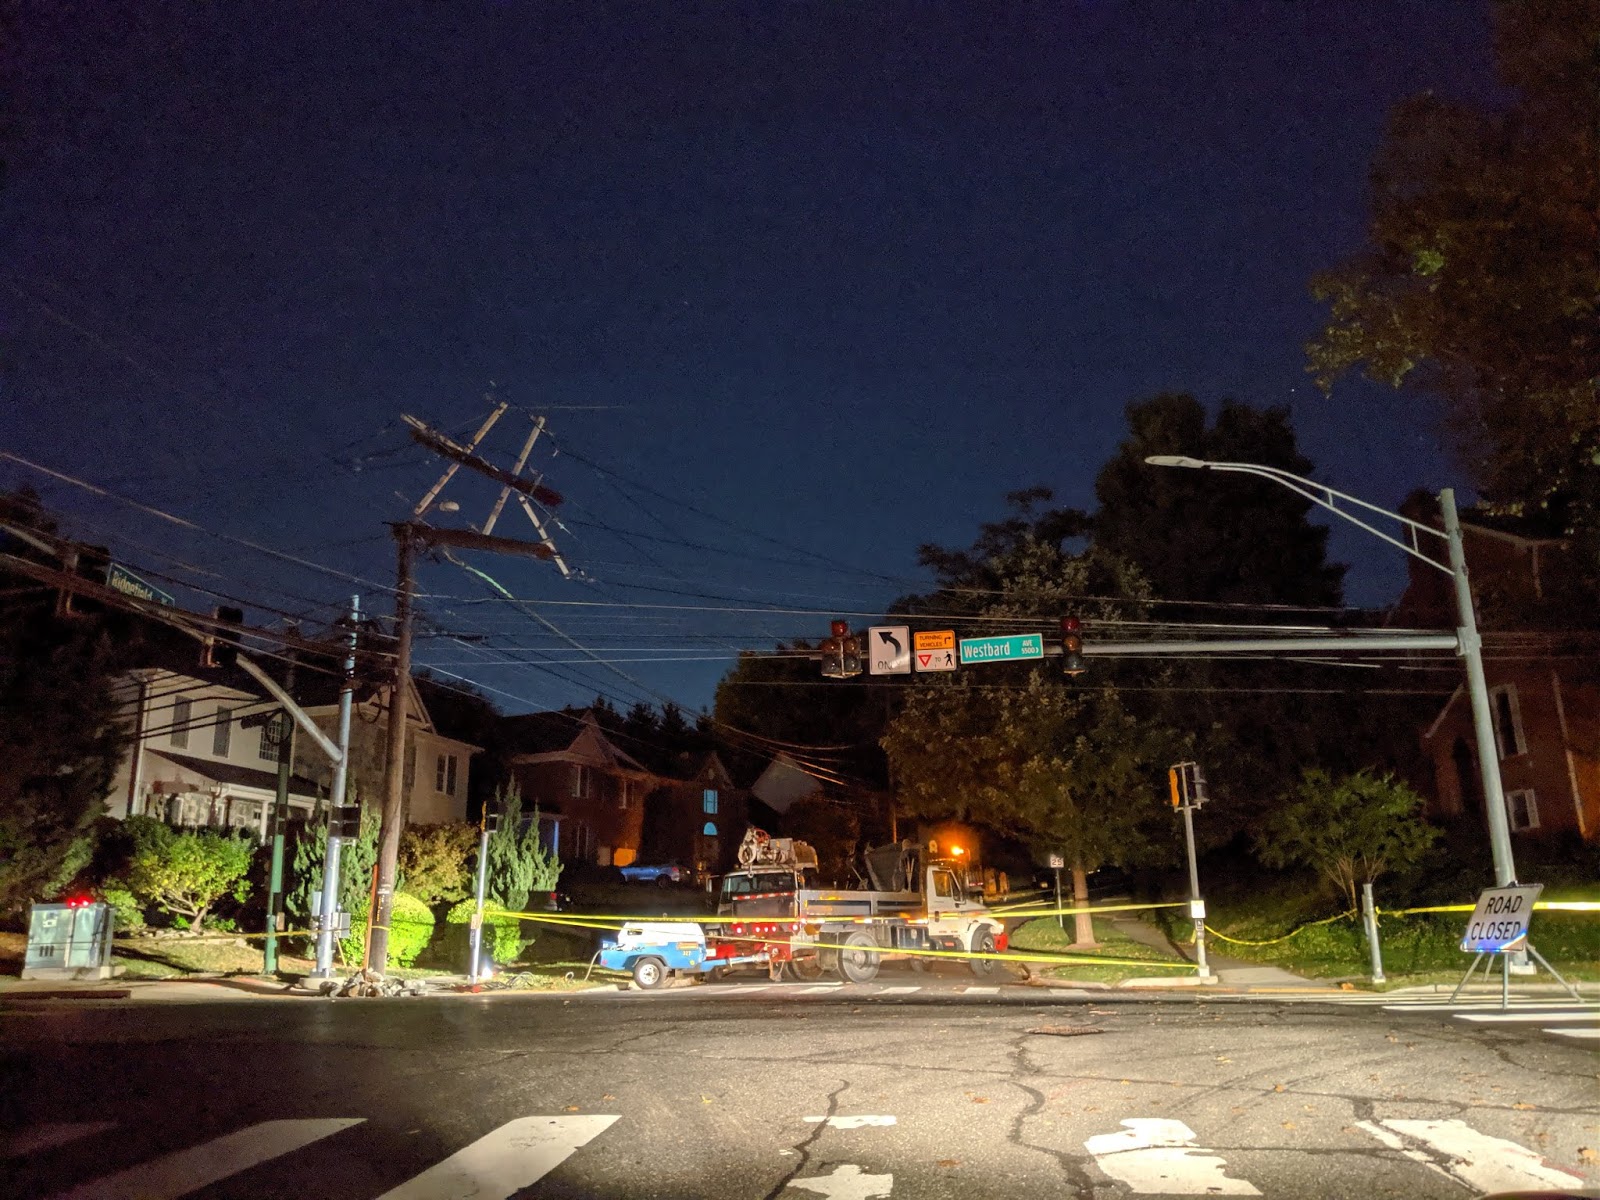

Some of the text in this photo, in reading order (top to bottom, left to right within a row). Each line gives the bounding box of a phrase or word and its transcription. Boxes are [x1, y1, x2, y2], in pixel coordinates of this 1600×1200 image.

[963, 641, 1011, 658] Westbard
[1022, 639, 1033, 647] AVE
[877, 660, 902, 670] ONY
[1484, 895, 1523, 915] ROAD
[1470, 921, 1521, 941] CLOSED
